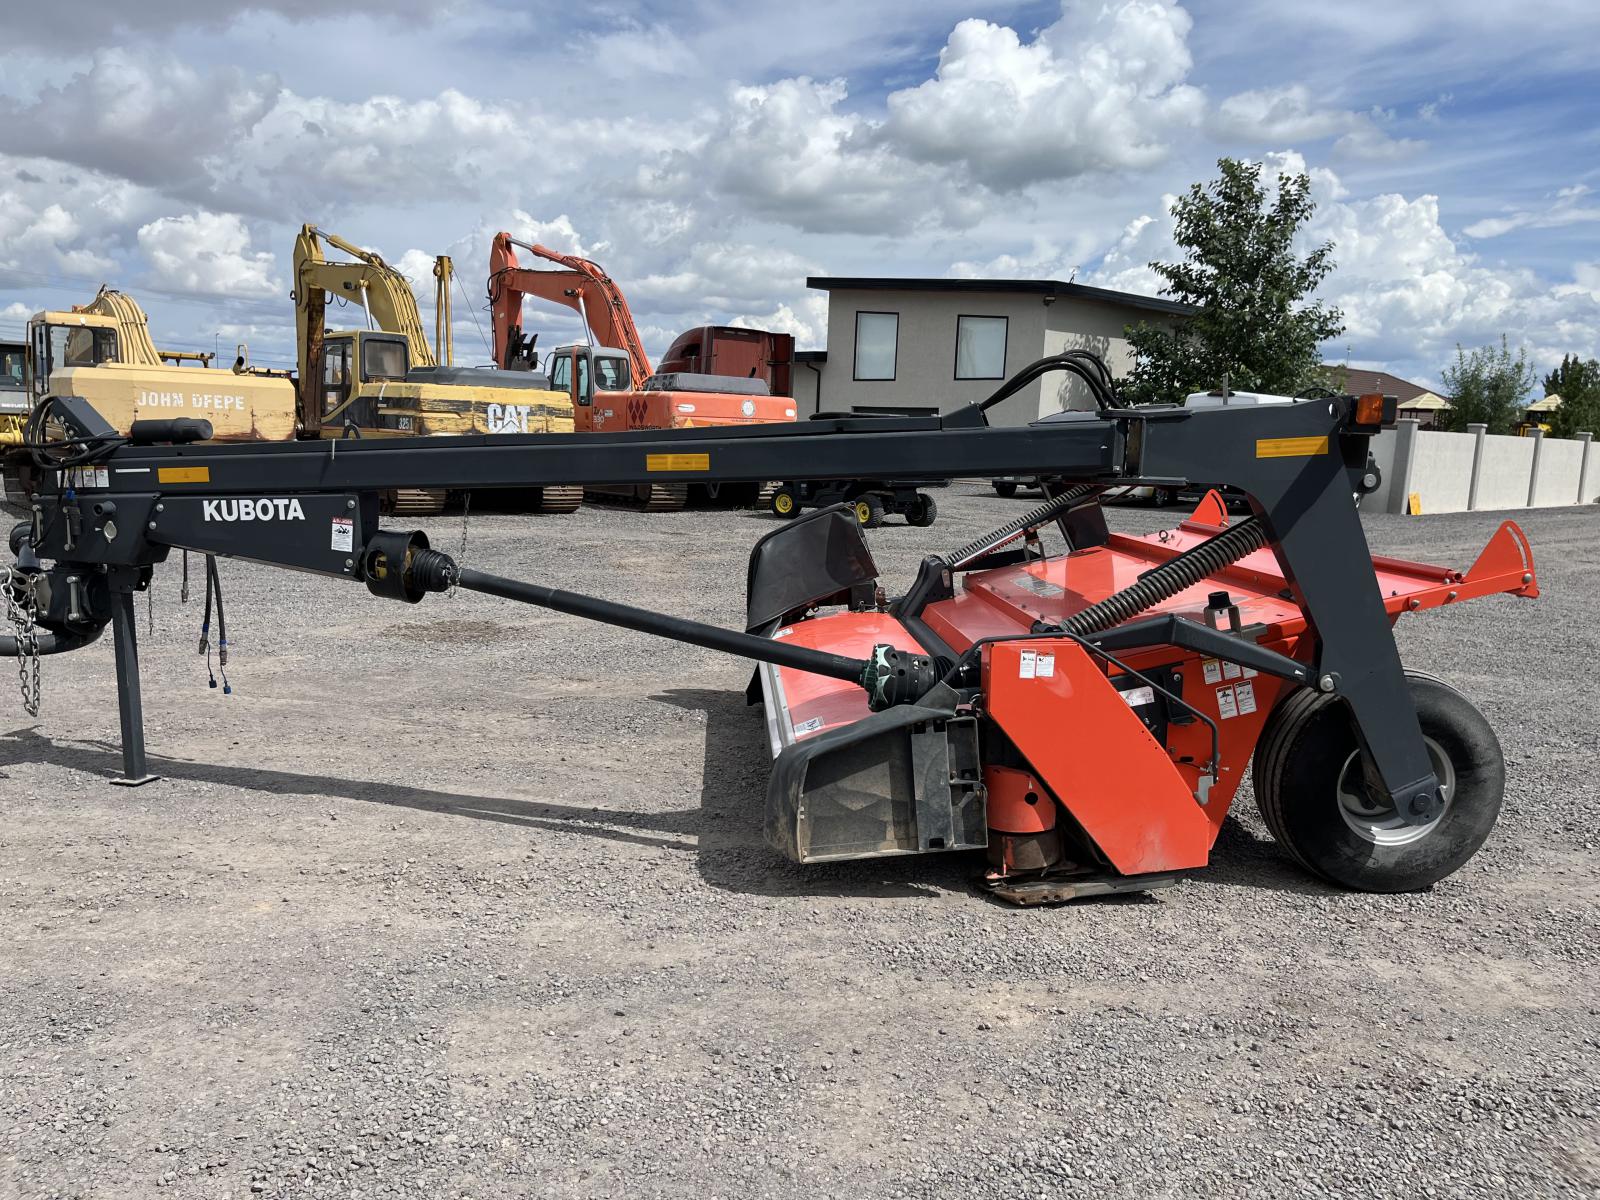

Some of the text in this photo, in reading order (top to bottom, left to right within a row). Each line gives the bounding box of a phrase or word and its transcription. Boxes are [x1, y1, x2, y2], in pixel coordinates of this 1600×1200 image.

[136, 391, 184, 407] JOHN
[487, 403, 532, 434] CAT
[202, 498, 306, 522] KUBOTA
